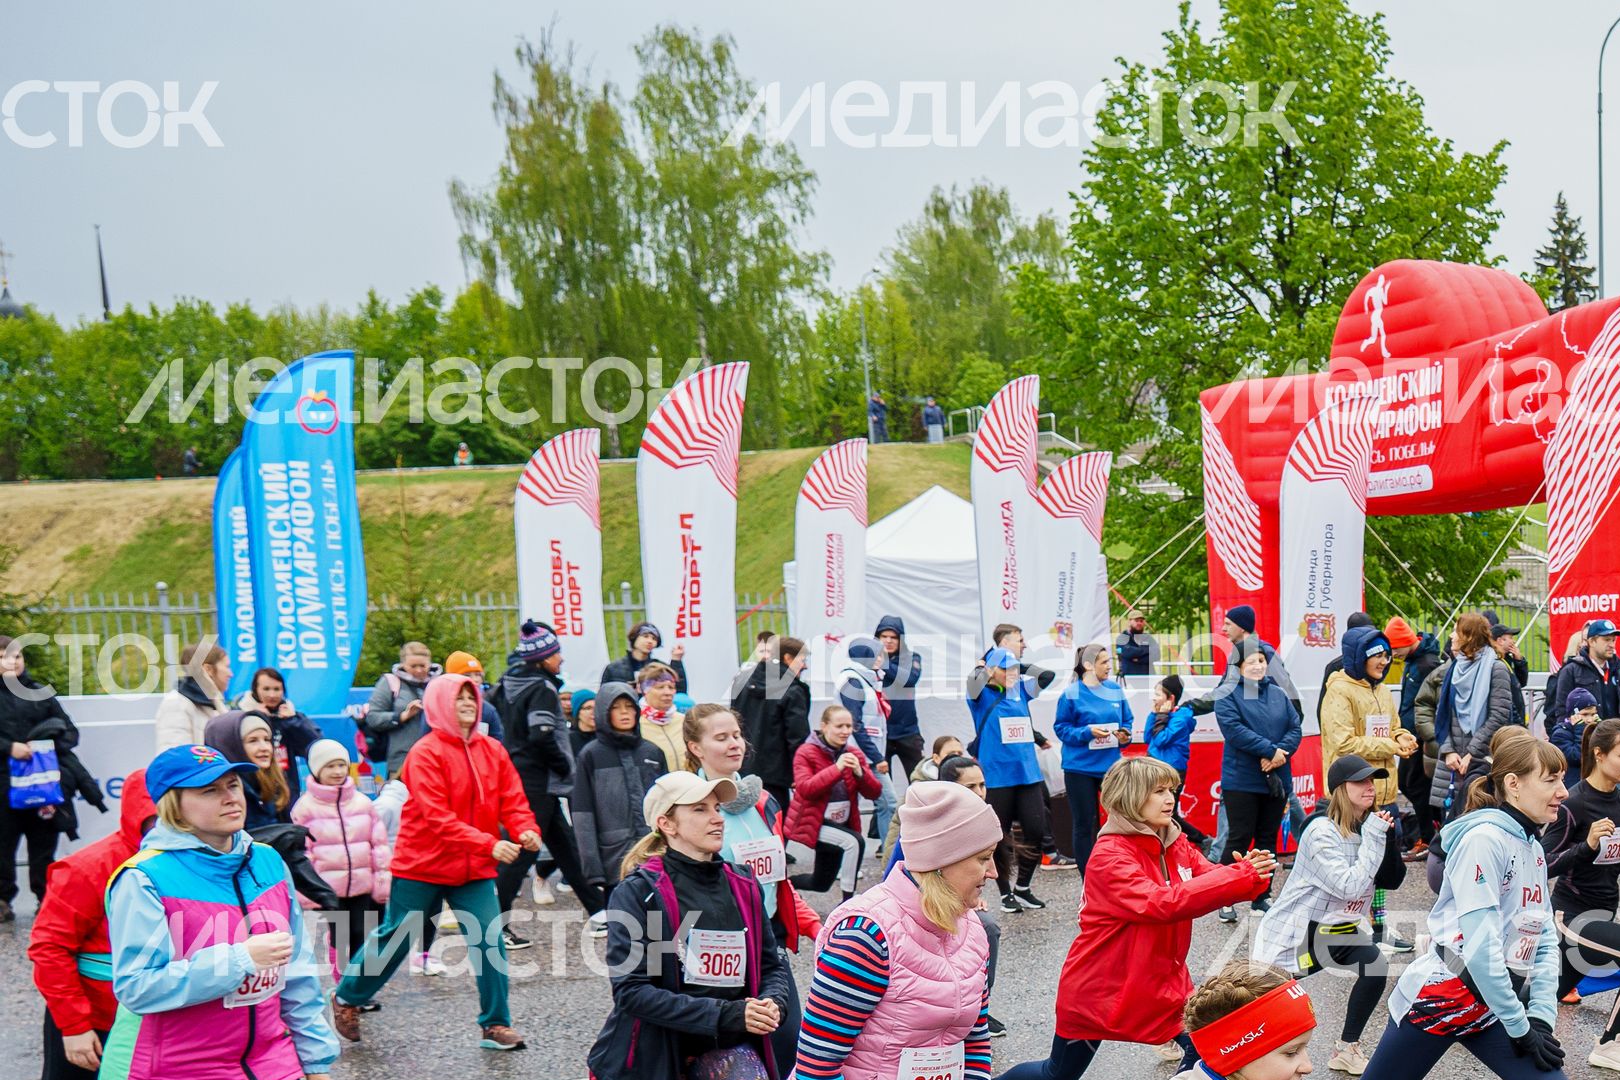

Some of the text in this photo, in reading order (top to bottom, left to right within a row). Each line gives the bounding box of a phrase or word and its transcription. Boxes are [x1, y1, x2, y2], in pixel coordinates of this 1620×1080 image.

[1373, 400, 1442, 440] АРАФОН
[259, 462, 298, 669] КОЛОМЕНСКИЙ
[288, 460, 328, 669] ПОЛУМАРАФОН
[568, 562, 583, 636] СПОРТ
[689, 541, 701, 637] СПОРТ
[826, 532, 836, 617] СУПЕРЛИГА
[1306, 549, 1318, 609] Команда
[1320, 523, 1336, 609] Губернатора
[1551, 593, 1619, 615] самолет
[700, 953, 741, 977] 3062
